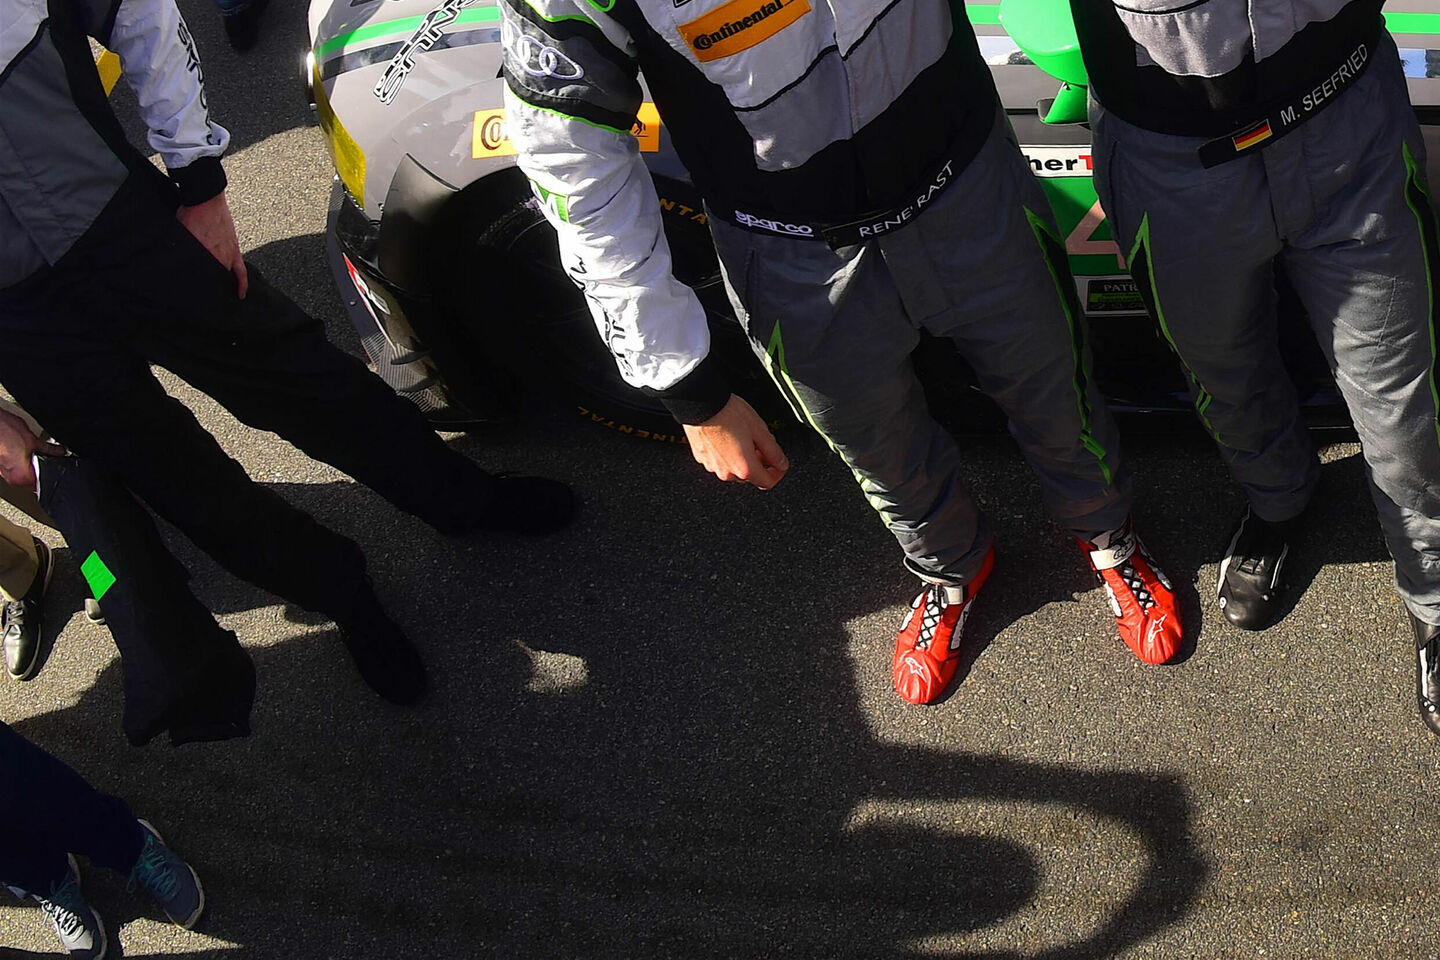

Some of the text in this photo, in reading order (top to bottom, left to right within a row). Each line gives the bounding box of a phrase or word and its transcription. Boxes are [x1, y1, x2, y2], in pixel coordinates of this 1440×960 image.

[1280, 44, 1368, 126] M. SEEFRIED
[916, 160, 953, 208] RAST
[735, 210, 814, 237] sparco
[1103, 284, 1137, 292] PATR
